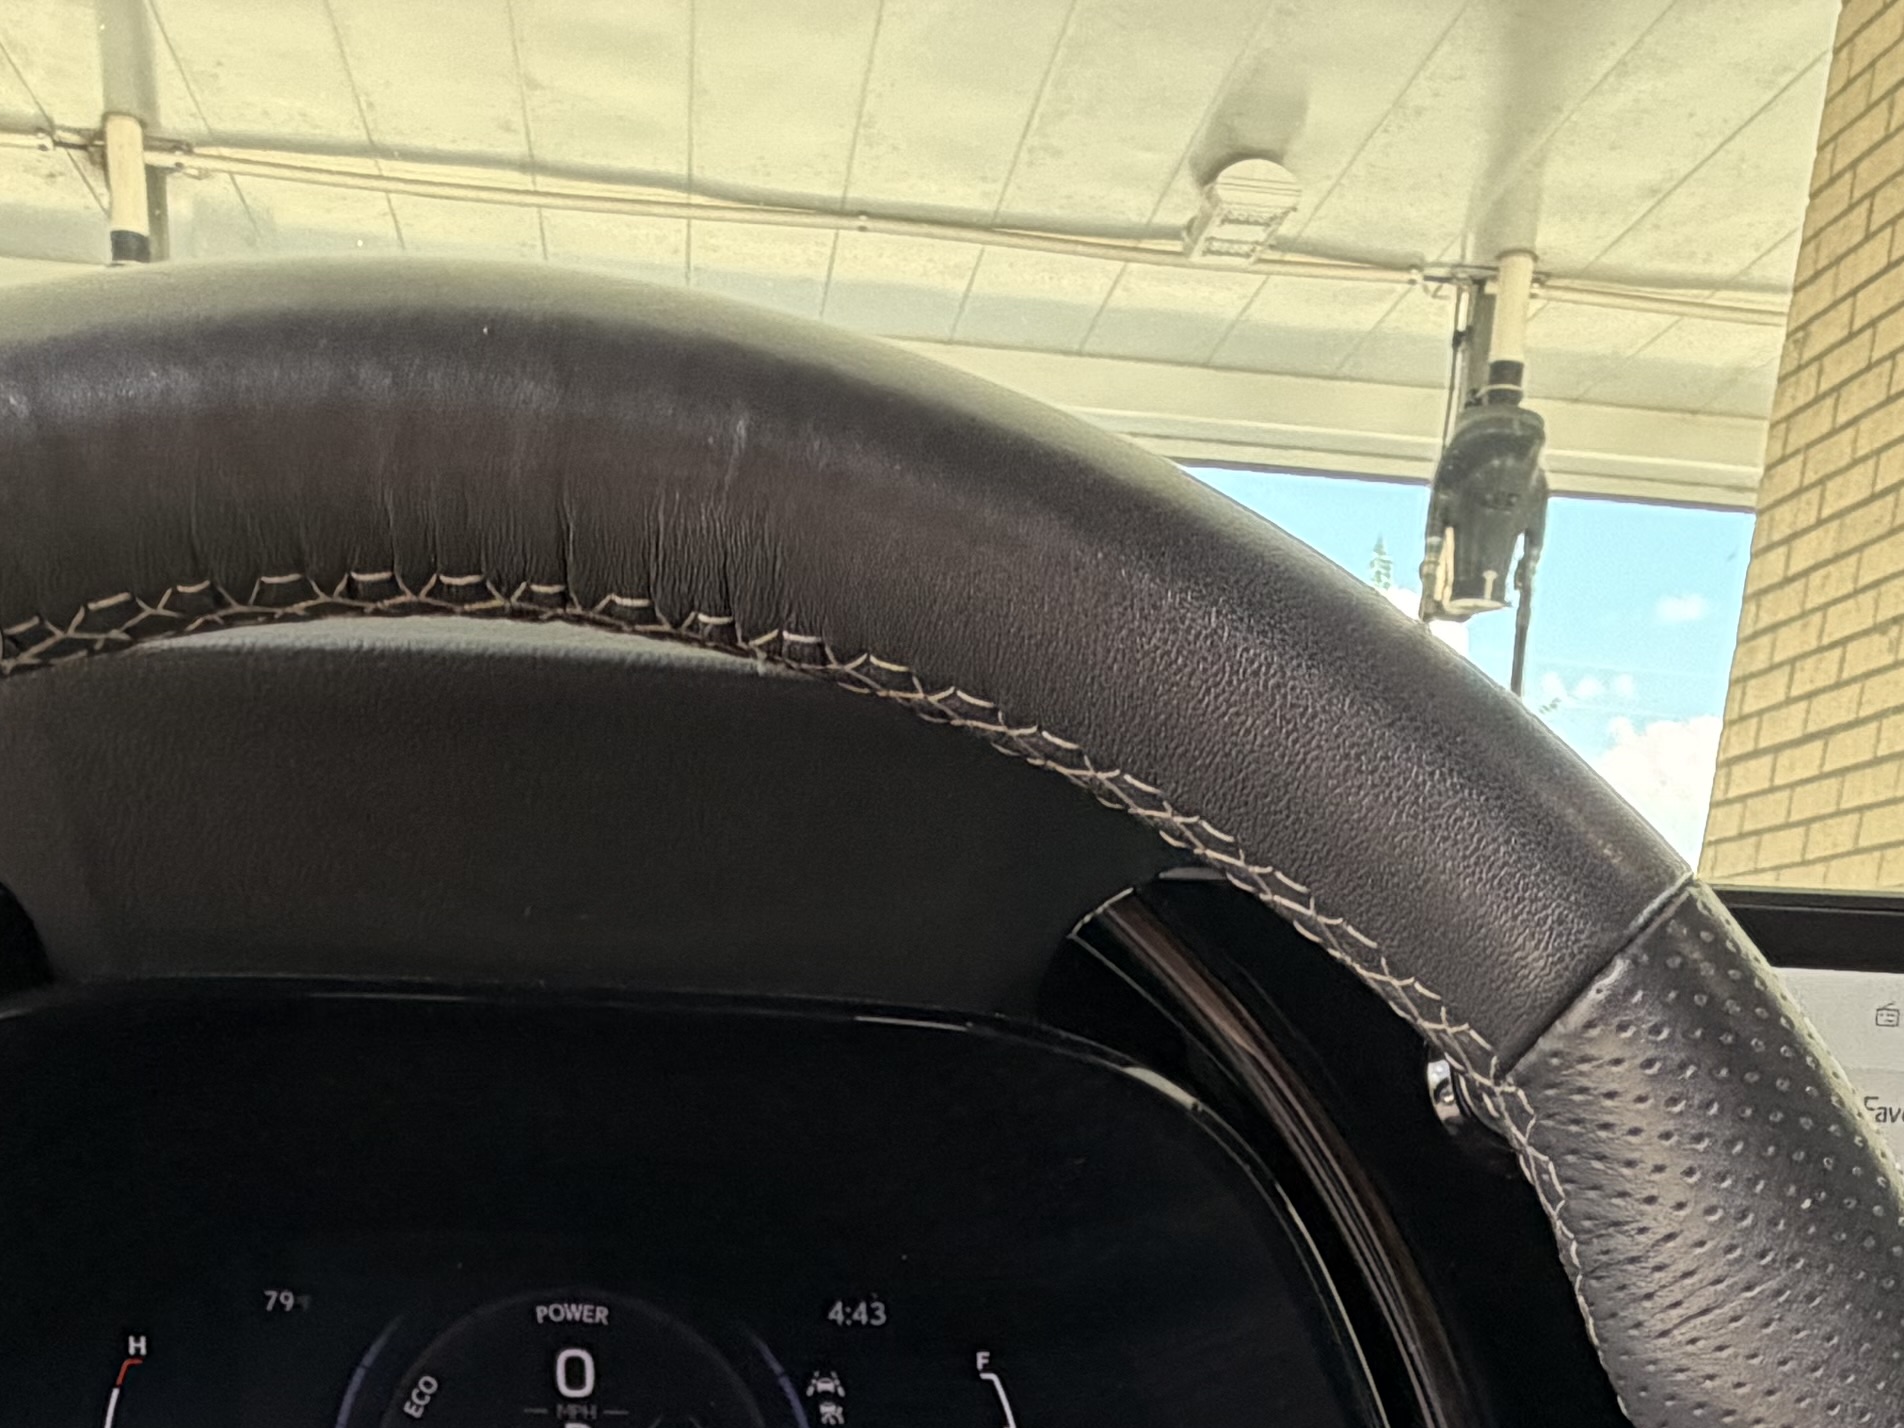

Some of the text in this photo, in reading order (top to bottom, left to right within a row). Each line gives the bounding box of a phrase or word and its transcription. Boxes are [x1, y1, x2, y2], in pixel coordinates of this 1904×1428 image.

[535, 1302, 610, 1325] POWER
[827, 1299, 887, 1326] 4:43
[128, 1334, 147, 1356] H
[555, 1348, 596, 1398] 0
[975, 1350, 991, 1372] F
[402, 1373, 440, 1420] ECO
